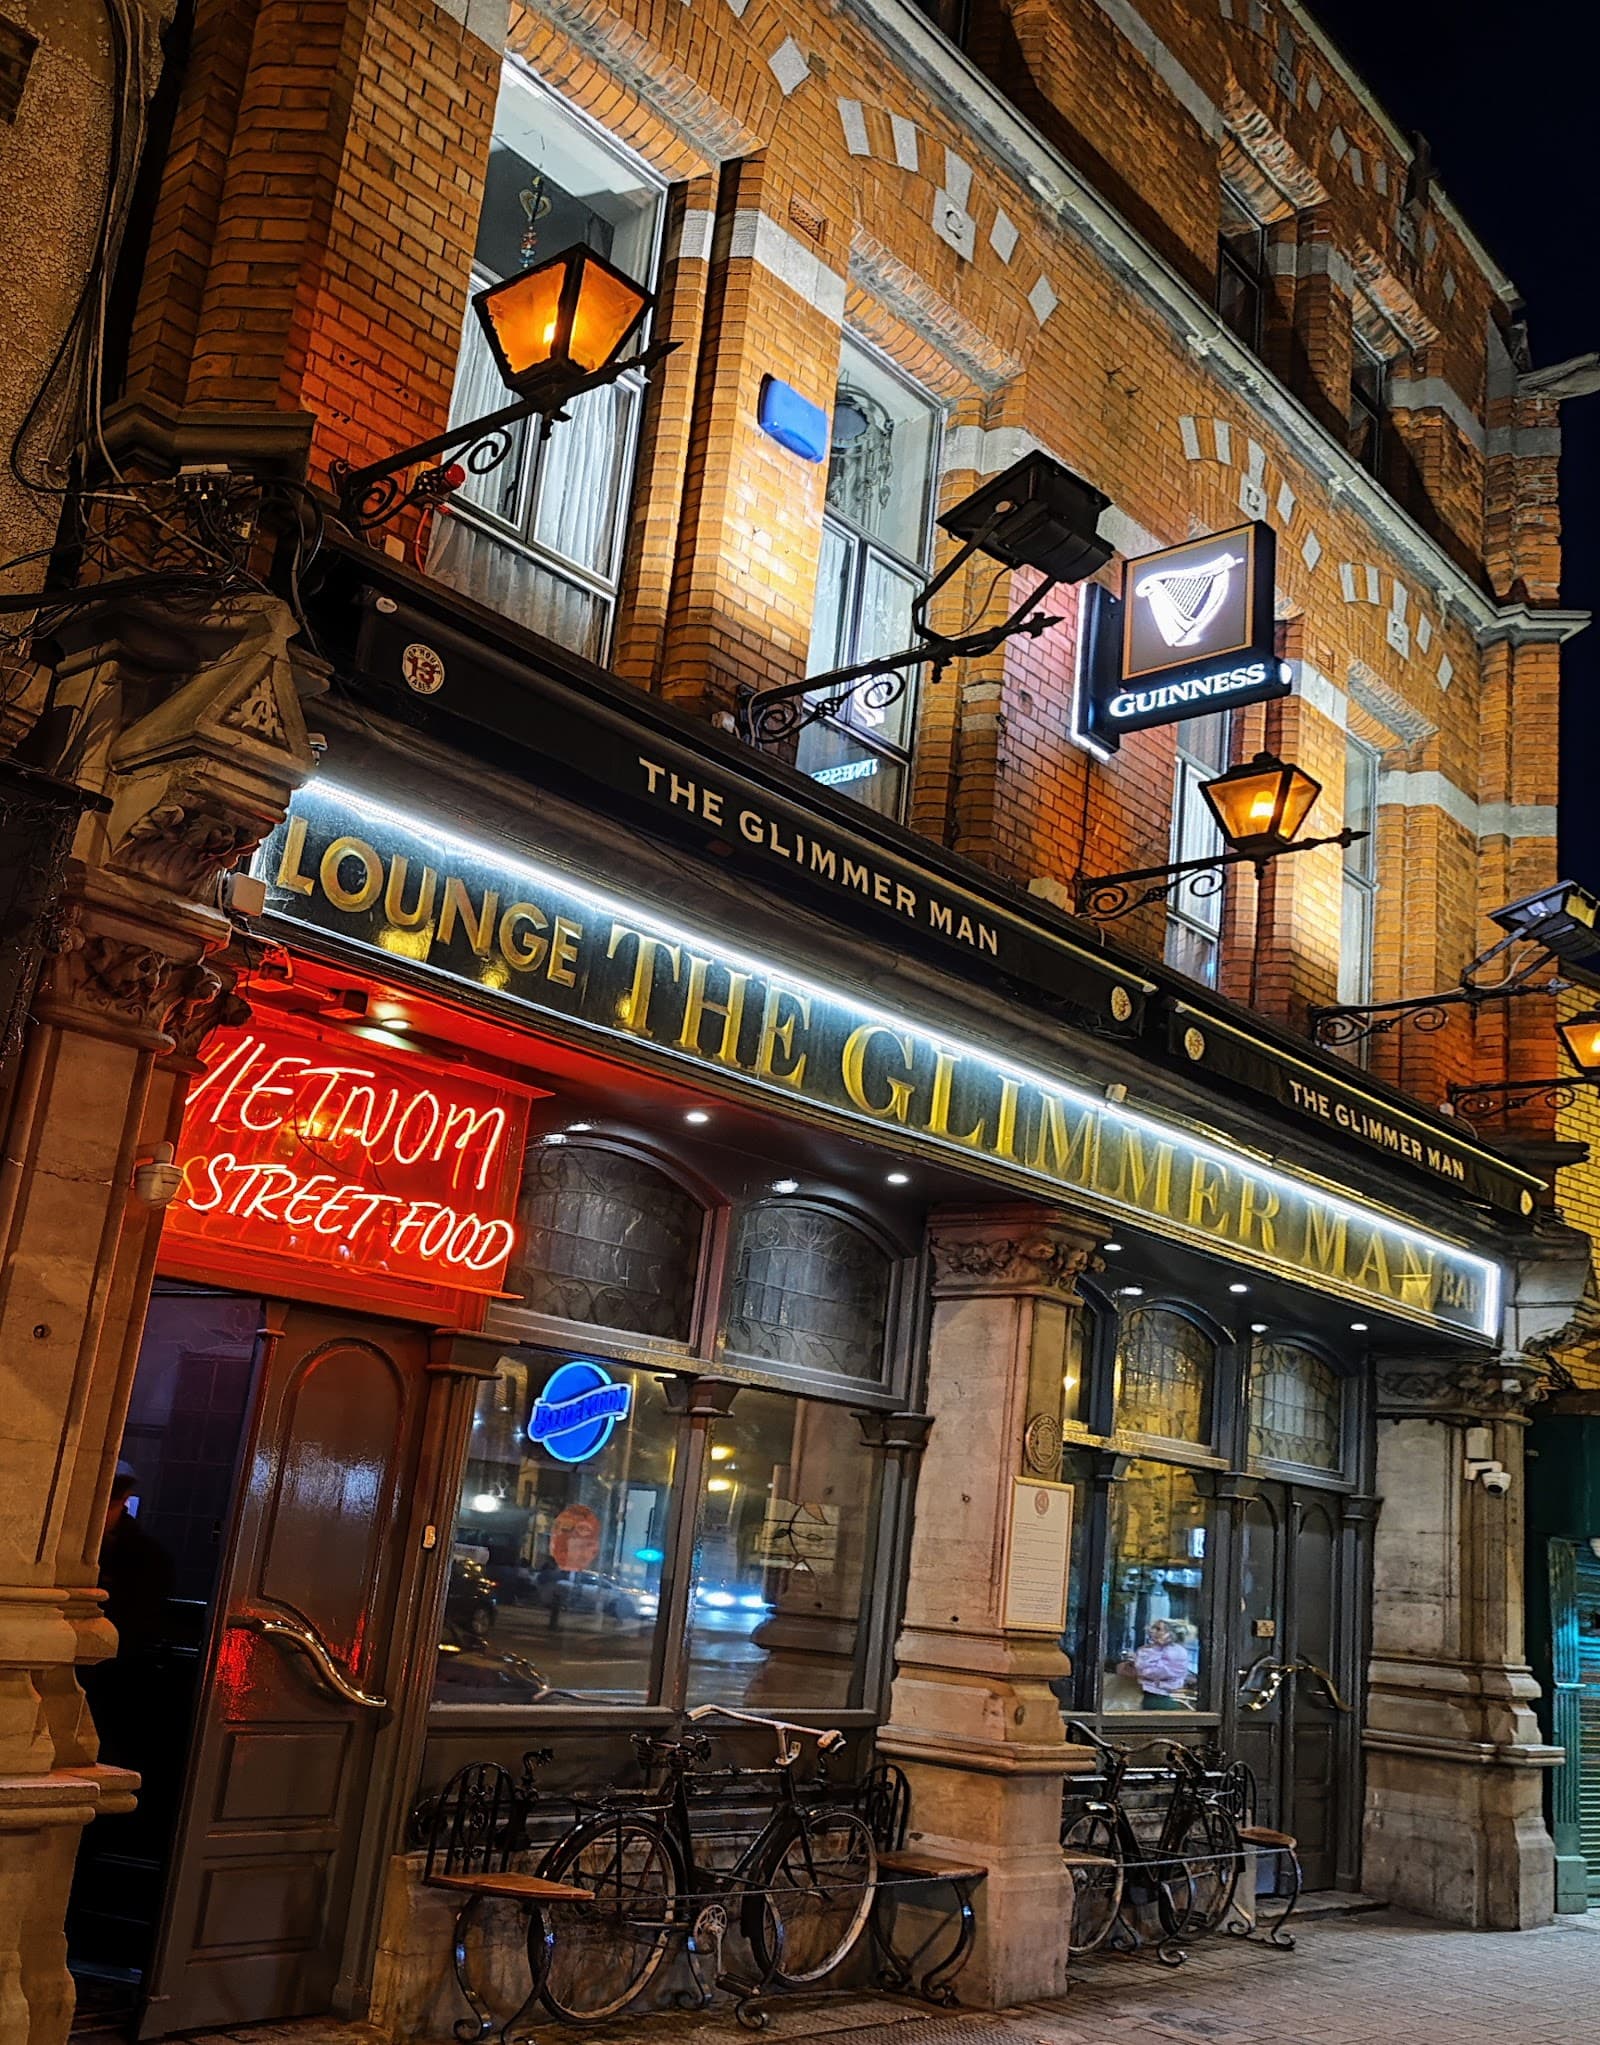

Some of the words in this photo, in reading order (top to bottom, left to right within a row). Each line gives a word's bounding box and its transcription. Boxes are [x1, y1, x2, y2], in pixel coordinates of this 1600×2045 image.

[1109, 663, 1266, 717] GUINNESS
[276, 814, 583, 989] LOUNGE
[639, 756, 724, 827] THE
[739, 809, 916, 919] GLIMMER
[929, 900, 999, 957] MAN
[606, 918, 811, 1090] THE
[842, 1024, 1280, 1253] GLIMMER
[1301, 1199, 1437, 1313] MAN
[1289, 1079, 1331, 1119] THE
[1335, 1103, 1423, 1162] GLIMMER
[1427, 1147, 1465, 1181] MAN
[187, 1153, 402, 1239] STREET
[390, 1201, 515, 1271] FOOD
